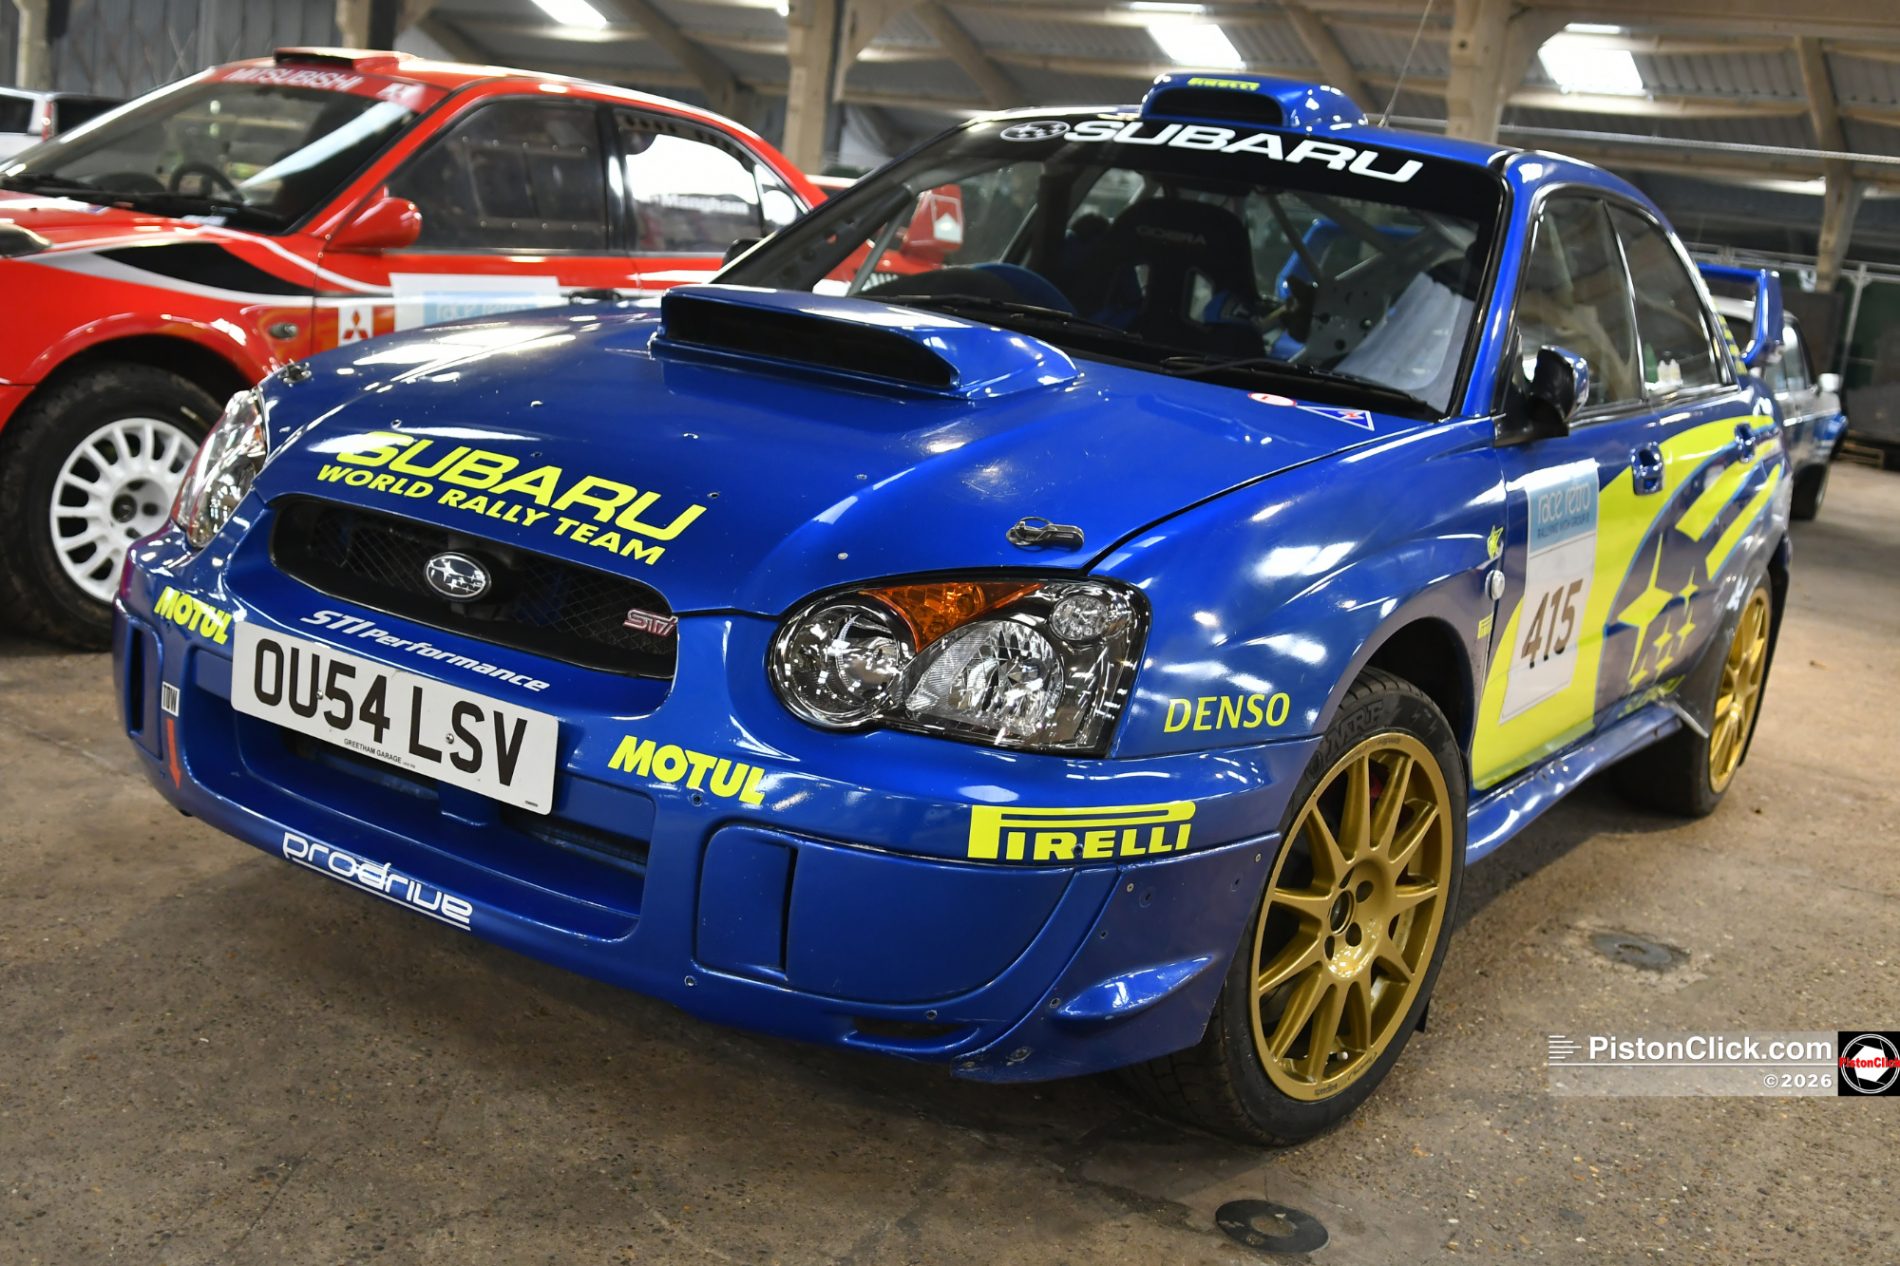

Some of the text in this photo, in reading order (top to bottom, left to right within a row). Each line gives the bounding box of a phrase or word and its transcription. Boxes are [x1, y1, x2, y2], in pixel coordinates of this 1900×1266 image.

[223, 68, 365, 91] MITSUBISHI
[1063, 120, 1424, 183] SUBARU
[316, 463, 666, 566] WORLD RALLY TEAM
[335, 431, 708, 541] SUBARU
[154, 586, 233, 645] MOTUL
[1521, 578, 1584, 669] 415
[254, 638, 528, 787] OU54 LSV
[1163, 692, 1291, 733] DENSO
[344, 738, 402, 764] GREETHAM GARAGE
[608, 734, 765, 806] MOTUL
[967, 800, 1197, 860] PIRELLI
[282, 832, 473, 926] prodrive
